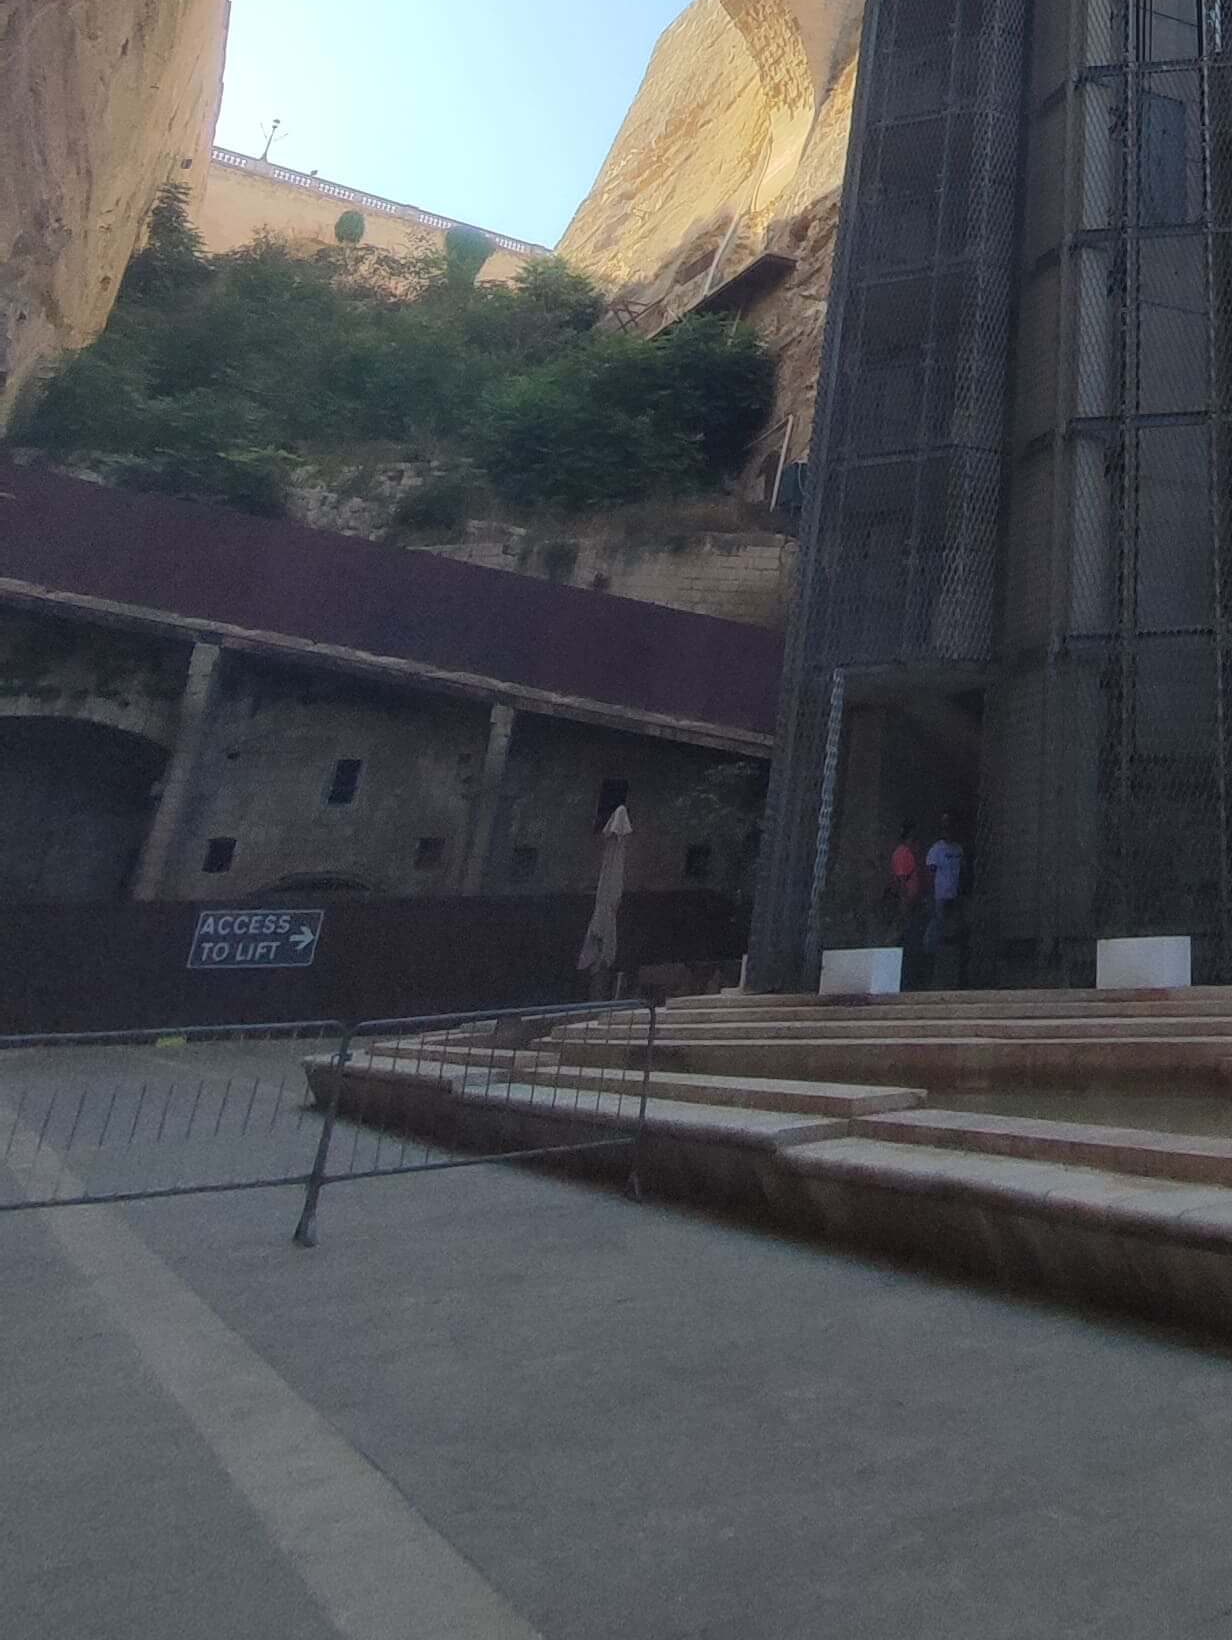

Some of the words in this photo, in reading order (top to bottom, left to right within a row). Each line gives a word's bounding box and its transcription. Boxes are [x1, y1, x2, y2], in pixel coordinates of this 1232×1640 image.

[199, 914, 291, 935] ACCESS
[200, 942, 229, 962] TO
[235, 941, 281, 961] LIFT
